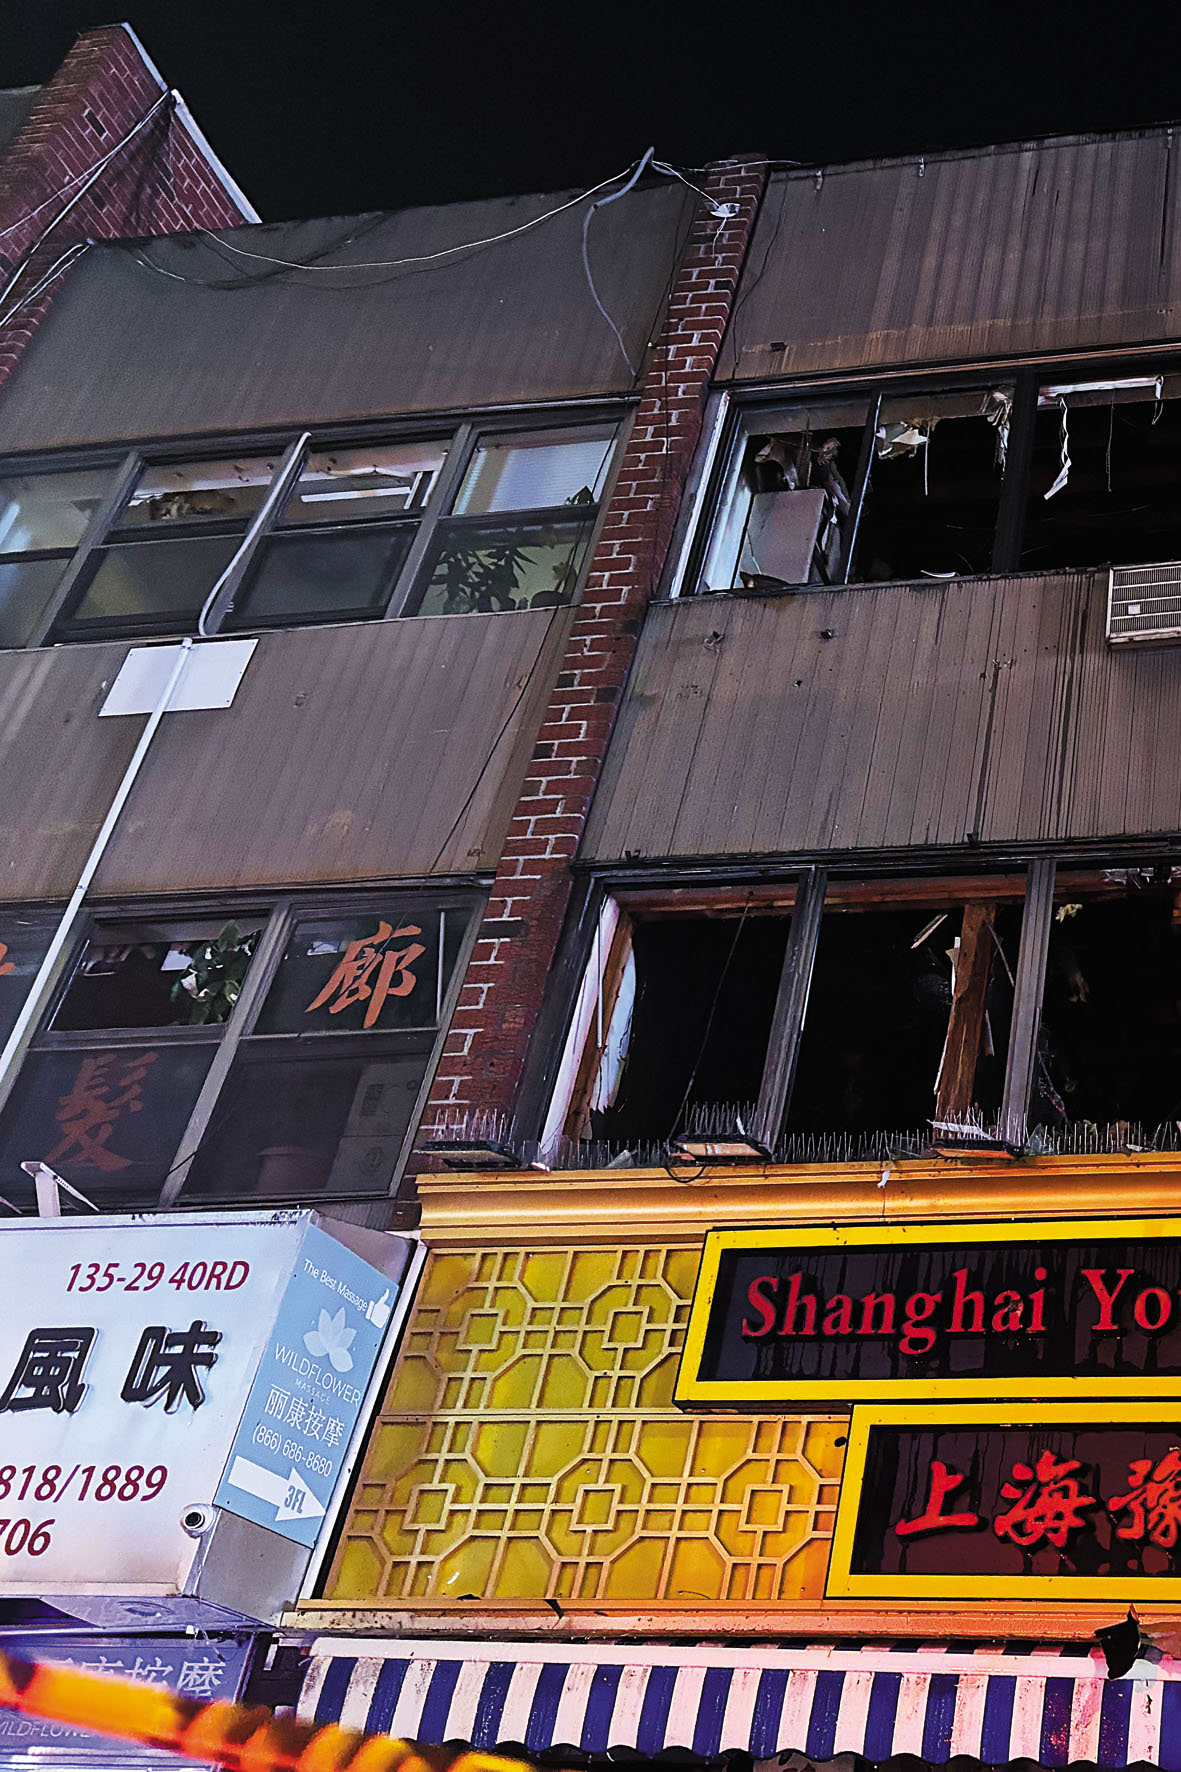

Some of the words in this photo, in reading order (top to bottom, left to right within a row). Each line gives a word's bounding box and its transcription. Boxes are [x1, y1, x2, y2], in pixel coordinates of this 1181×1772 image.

[305, 921, 426, 1029] 廊
[66, 1261, 165, 1292] 135-29
[168, 1260, 250, 1291] 40RD
[303, 1258, 319, 1279] The
[319, 1270, 337, 1291] Best
[337, 1281, 368, 1312] Massage
[742, 1267, 1047, 1355] Shanghai
[0, 1319, 223, 1415] 風味
[274, 1342, 361, 1407] WILDFLOWER
[295, 1376, 331, 1406] MASSAGE
[264, 1383, 345, 1448] 丽康按摩
[252, 1422, 282, 1455] (866)
[282, 1438, 333, 1478] 686-8680
[0, 1464, 168, 1503] 818/1889
[284, 1485, 306, 1515] 3FL
